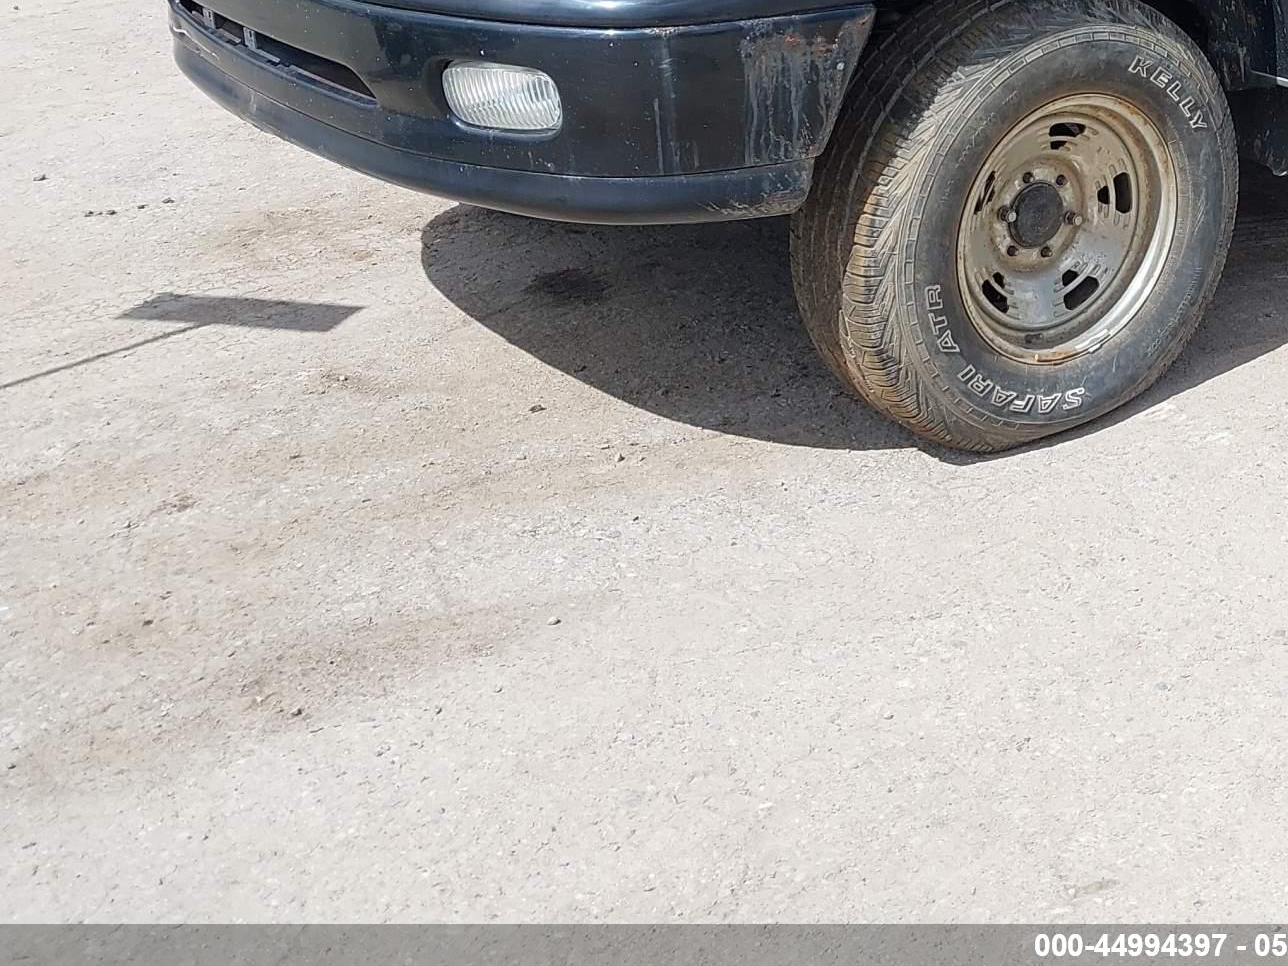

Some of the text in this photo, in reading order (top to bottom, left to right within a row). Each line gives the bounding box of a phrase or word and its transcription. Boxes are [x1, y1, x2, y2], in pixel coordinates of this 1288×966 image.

[1128, 55, 1208, 129] KELLY
[924, 284, 1086, 414] SAFARI ATR
